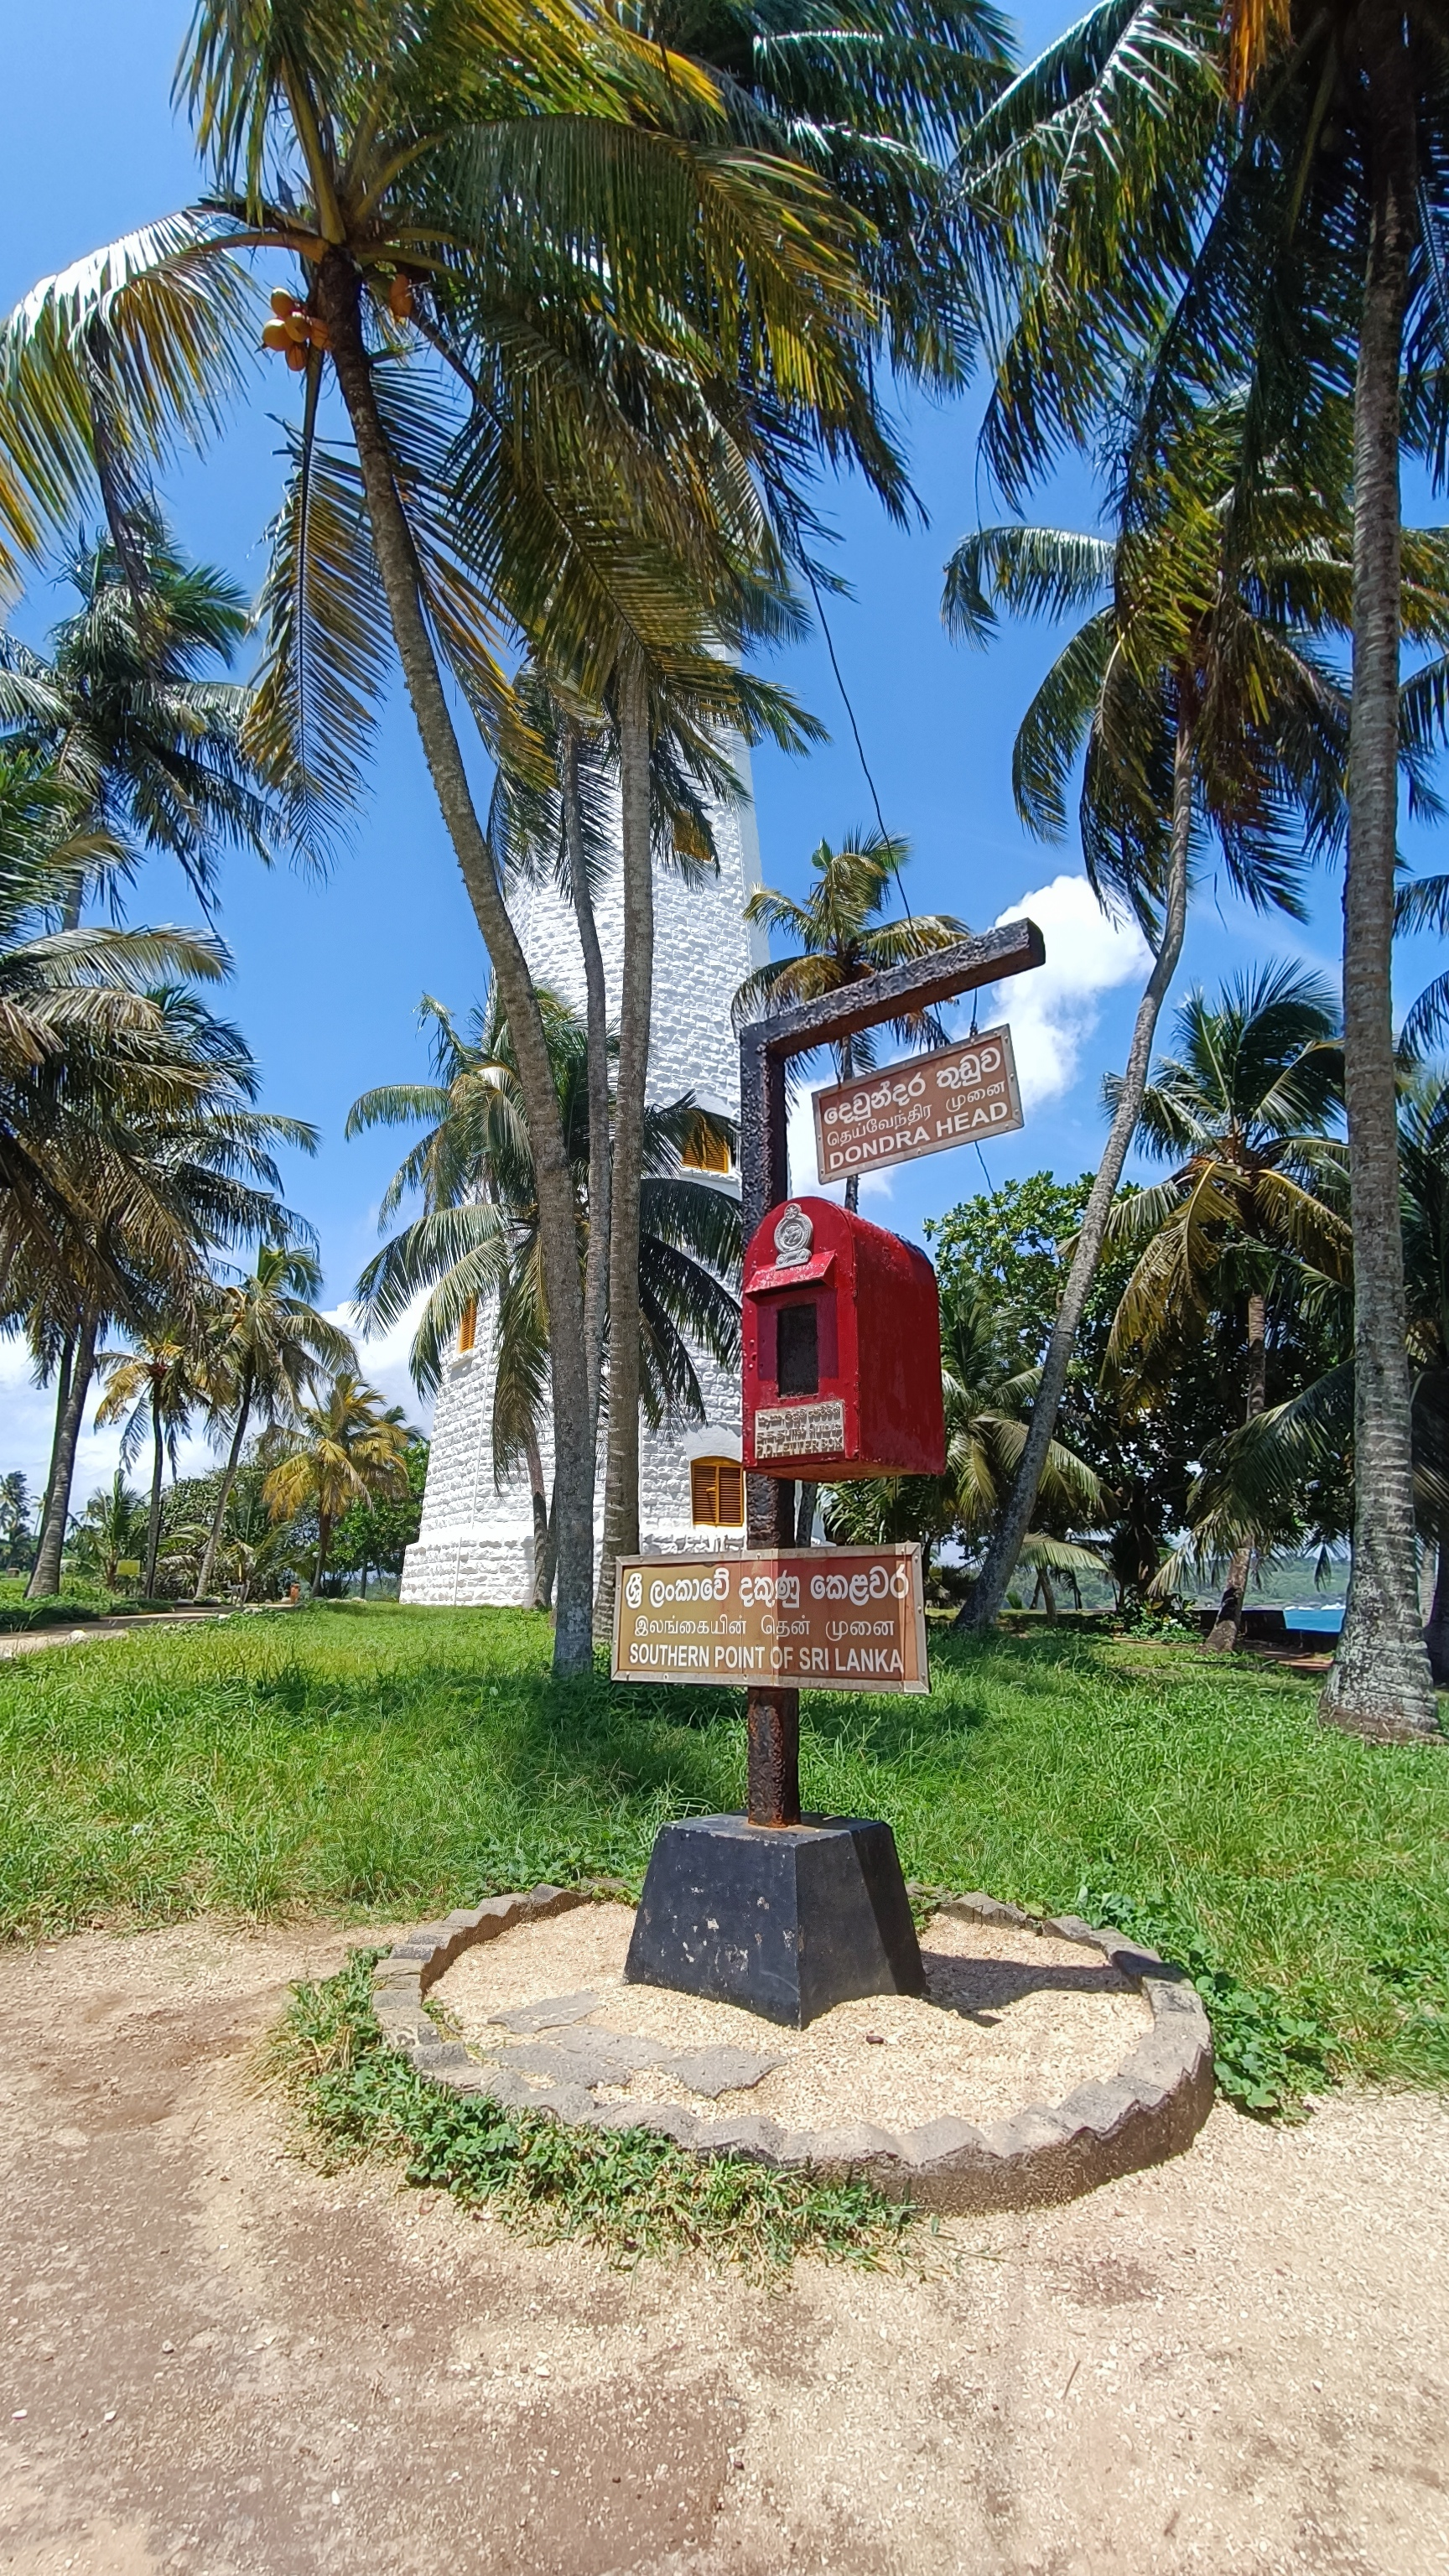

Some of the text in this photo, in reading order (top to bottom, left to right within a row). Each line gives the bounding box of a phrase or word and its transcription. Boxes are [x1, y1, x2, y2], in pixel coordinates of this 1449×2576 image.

[824, 1047, 1001, 1124] දෙවුන්දර තුඩුව
[827, 1081, 1005, 1146] தெய்வேந்திர முனை
[829, 1102, 1008, 1170] DONDRA HEAD
[820, 1436, 844, 1452] BOX
[626, 1564, 909, 1608] ශ්‍රී ලංකාවේ දකුණු කෙළවර
[635, 1613, 894, 1641] இலங்கையின் தென் முனை
[630, 1643, 905, 1673] SOUTHERN POINT OF SRI LANKA
